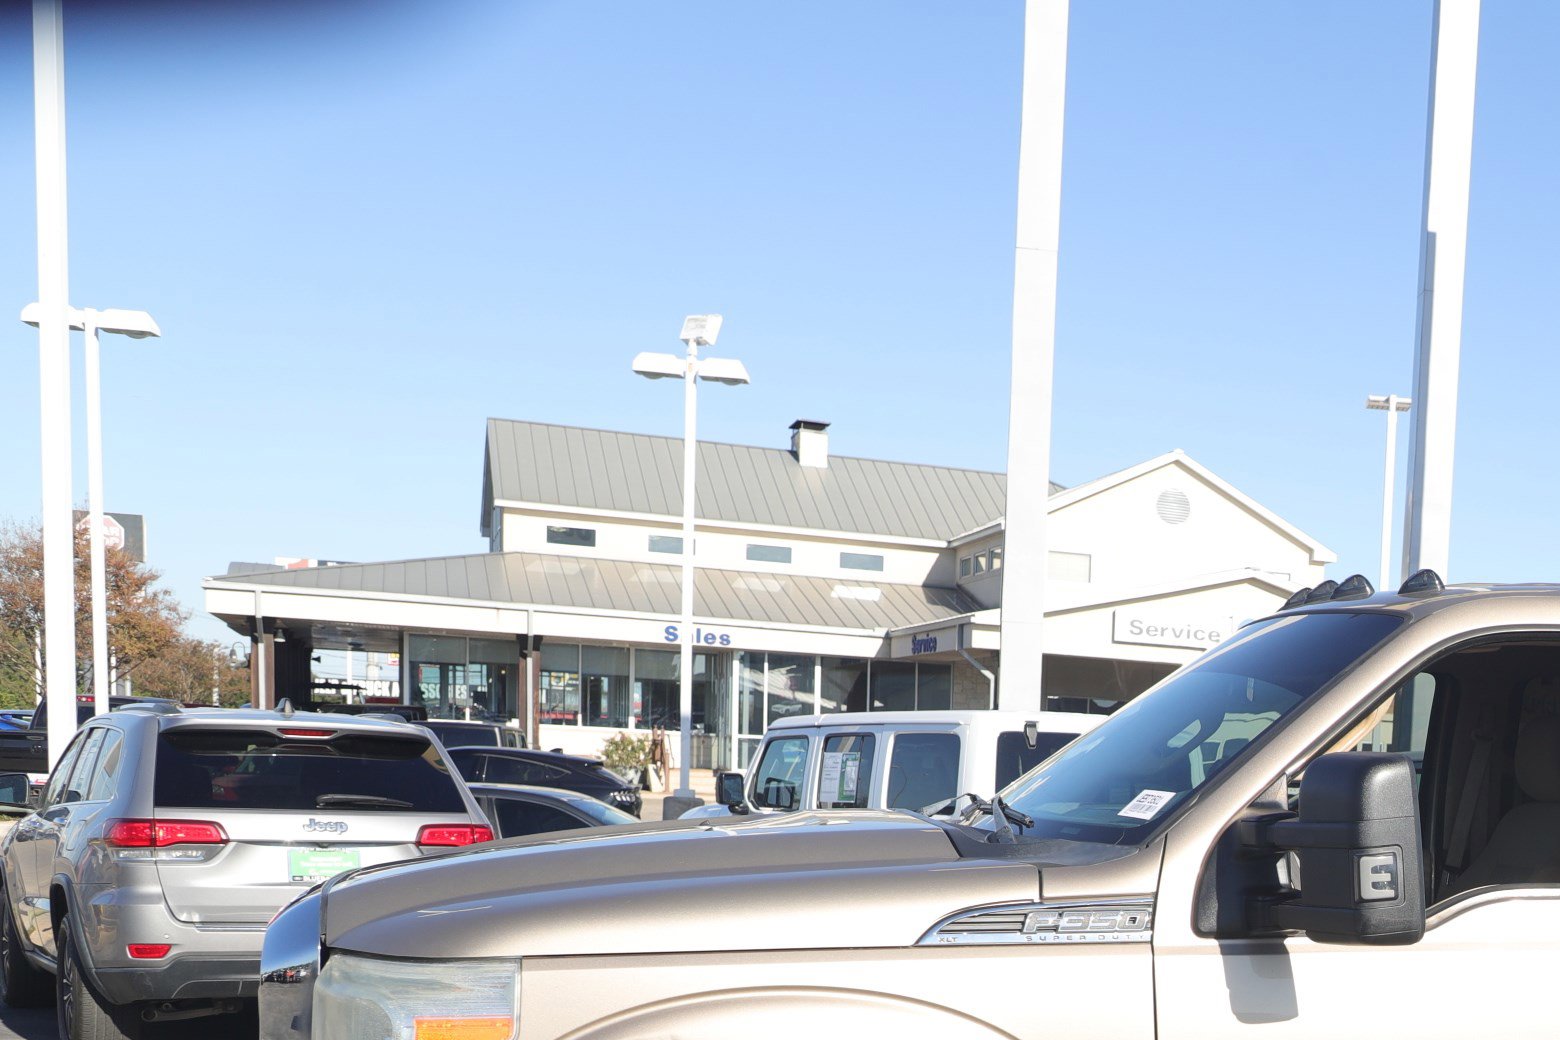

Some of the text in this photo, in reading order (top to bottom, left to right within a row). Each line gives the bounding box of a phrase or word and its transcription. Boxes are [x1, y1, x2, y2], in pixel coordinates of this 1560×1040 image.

[663, 625, 731, 646] Sles
[1129, 619, 1221, 643] Service
[303, 818, 348, 835] Jeep
